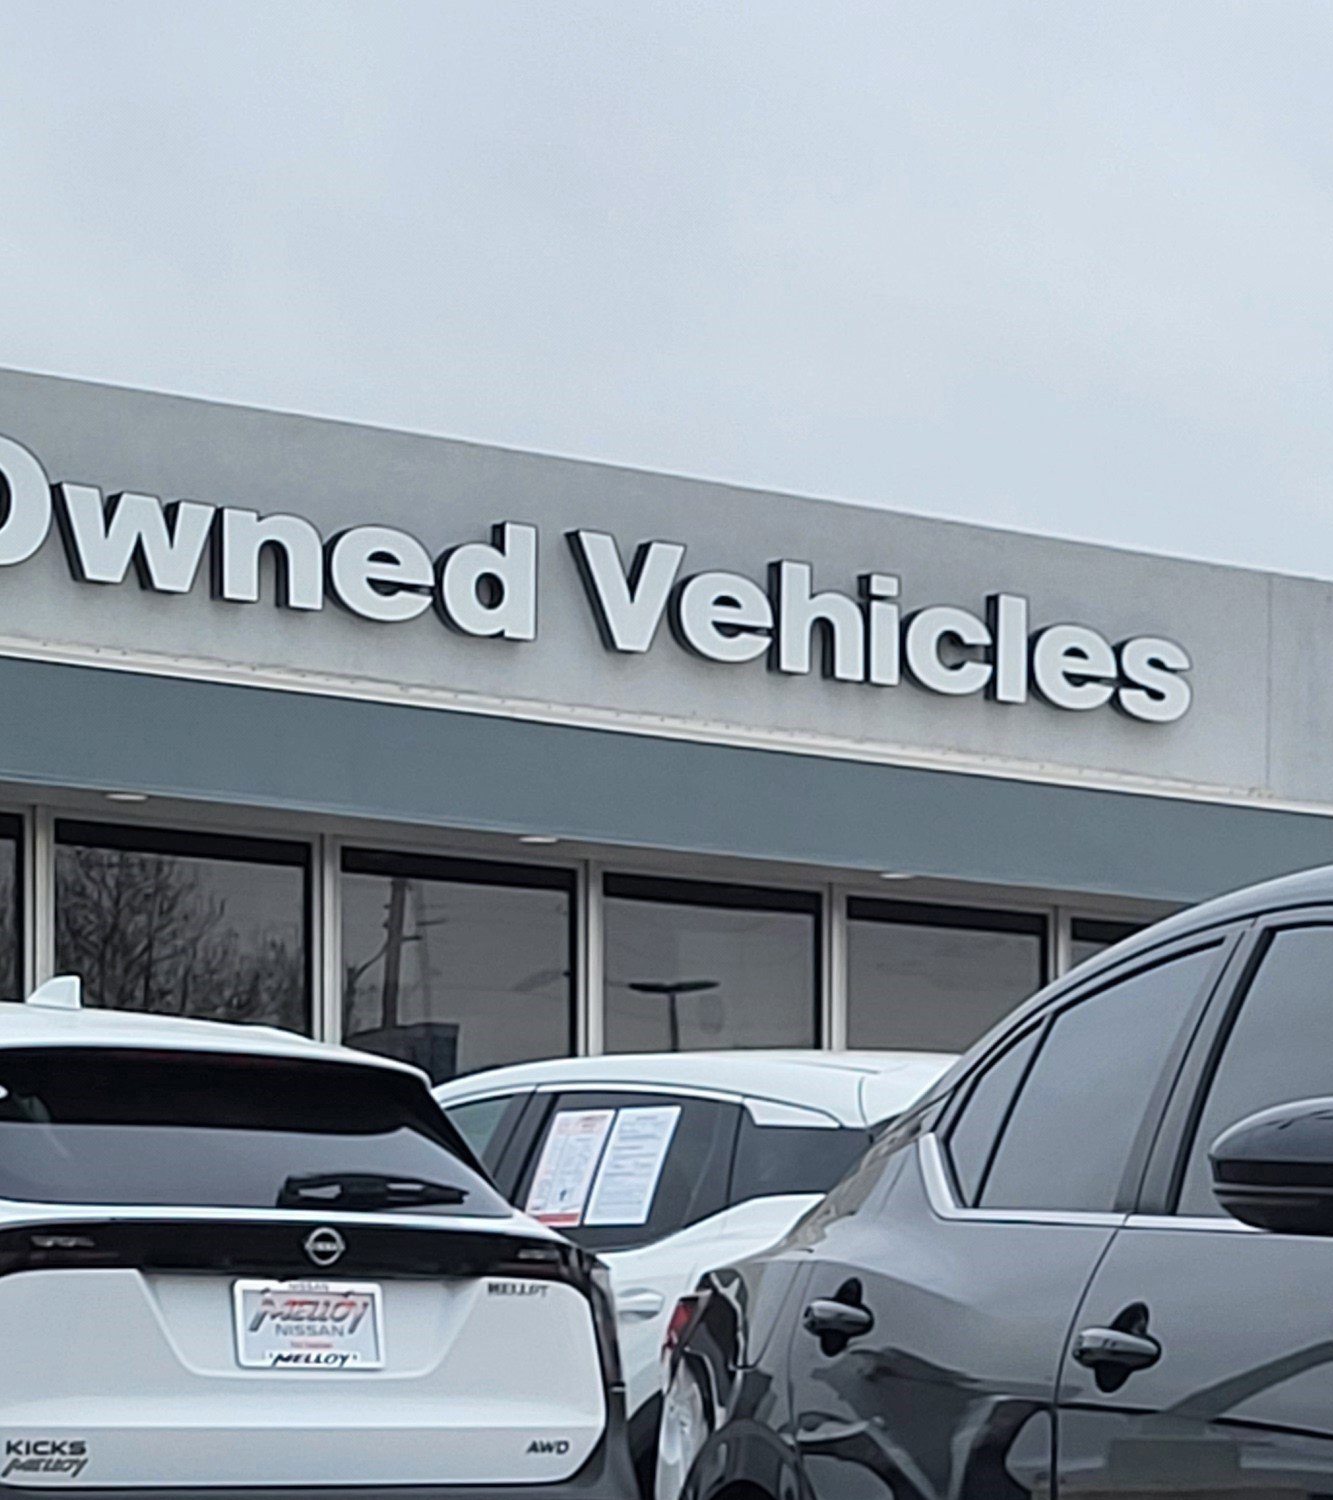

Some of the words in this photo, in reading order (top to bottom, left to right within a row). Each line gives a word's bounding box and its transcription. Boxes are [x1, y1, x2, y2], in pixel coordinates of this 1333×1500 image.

[566, 529, 1194, 724] Vehicles
[275, 1324, 345, 1337] NISSAN
[272, 1352, 350, 1367] MELLOY
[6, 1440, 86, 1456] KICKS
[526, 1440, 569, 1455] AWD
